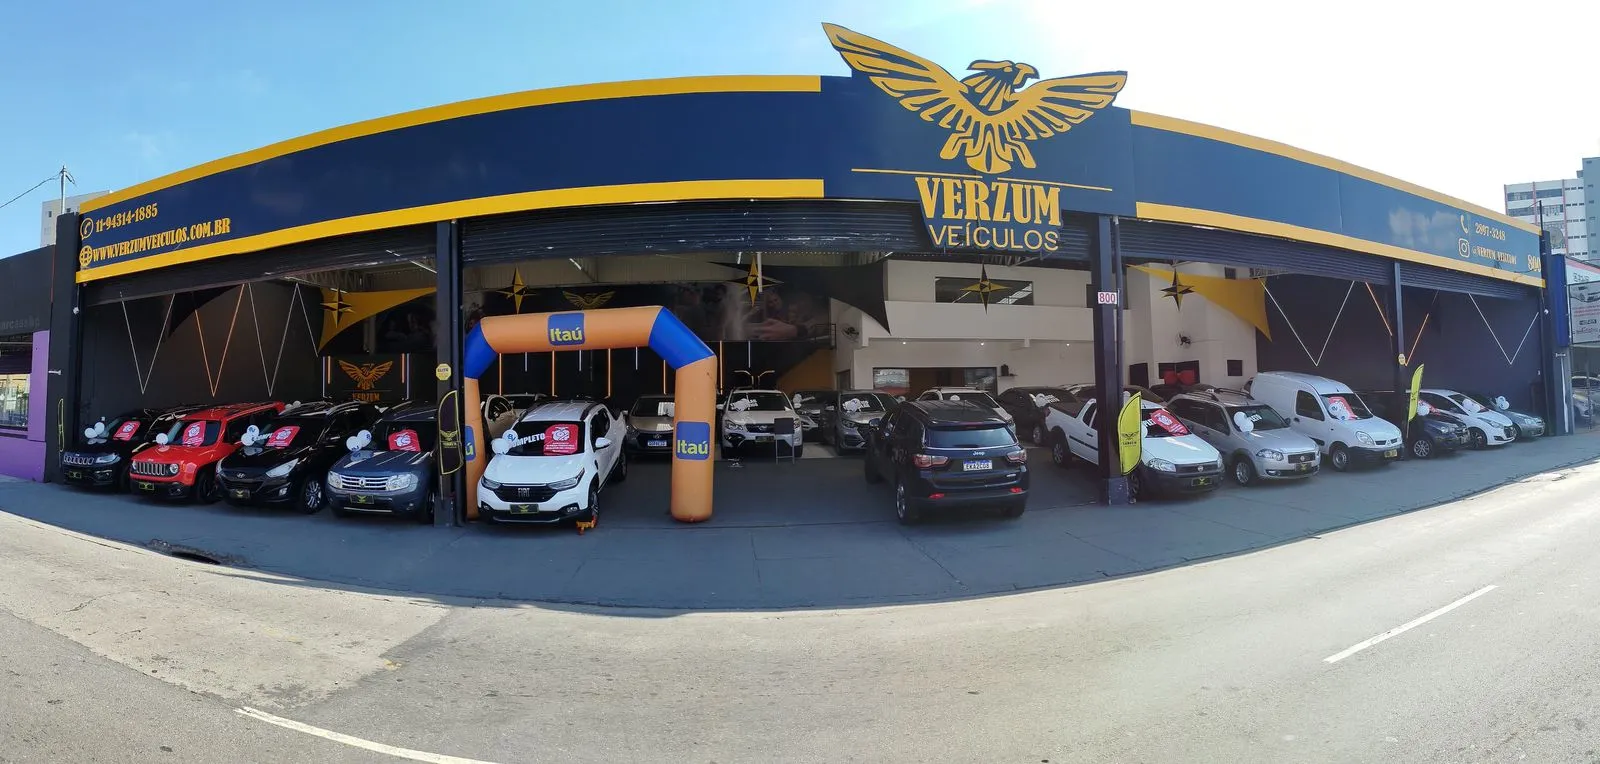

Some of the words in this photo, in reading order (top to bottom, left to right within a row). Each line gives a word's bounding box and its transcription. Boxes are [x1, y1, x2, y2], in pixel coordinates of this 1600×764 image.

[914, 177, 1061, 226] VERZUM
[95, 203, 158, 233] 11-94314-1885
[92, 217, 231, 262] WWW.VERZUMVEICULOS.COM.BR
[928, 222, 1059, 250] VEÍCULOS
[1099, 292, 1116, 303] 800
[550, 327, 583, 341] Itaú
[512, 433, 546, 447] OMPLETO
[677, 440, 708, 455] Itaú
